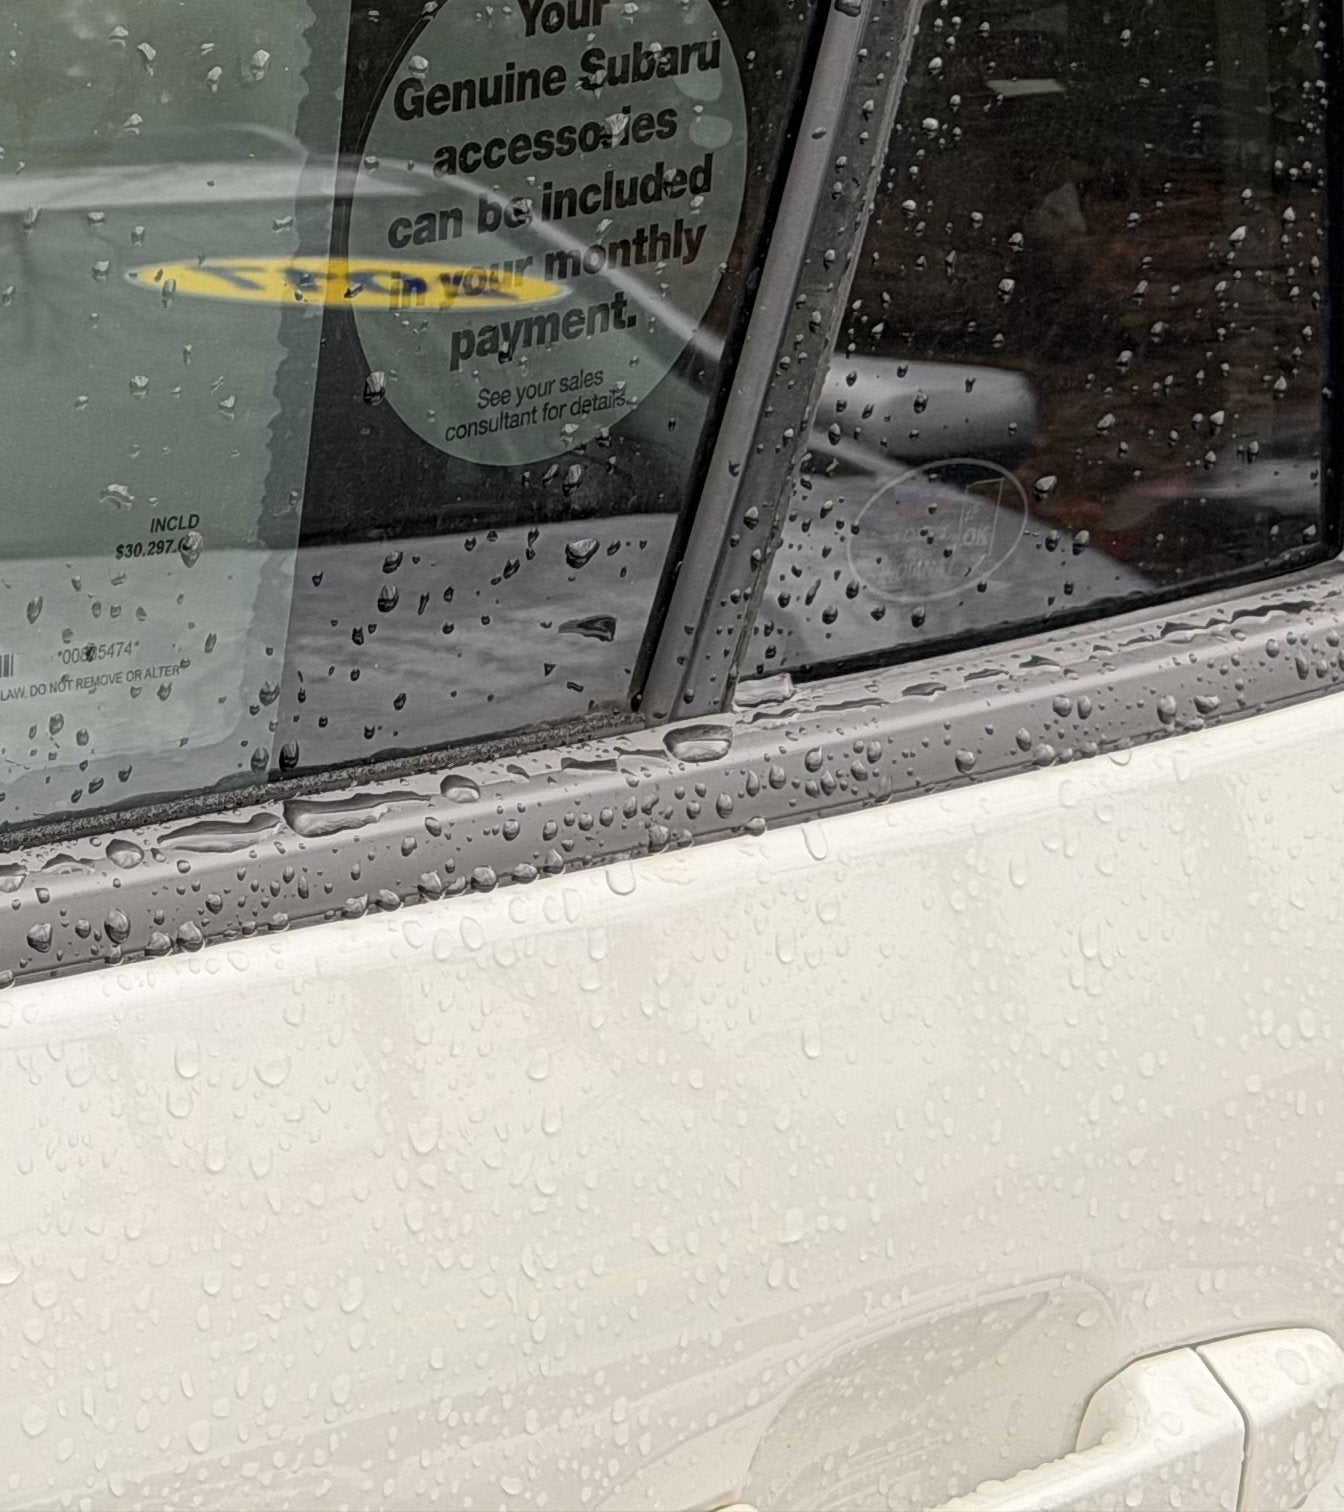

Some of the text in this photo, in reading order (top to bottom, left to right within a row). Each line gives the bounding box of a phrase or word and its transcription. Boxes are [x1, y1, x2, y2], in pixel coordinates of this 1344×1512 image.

[393, 38, 721, 122] Genuine Subaru
[387, 207, 464, 248] can
[540, 153, 715, 221] included
[438, 259, 535, 311] your
[545, 219, 708, 281] monthly
[449, 292, 637, 371] payment.
[445, 410, 539, 441] consultant
[542, 399, 567, 422] for
[478, 367, 604, 410] See your sales
[149, 513, 200, 534] INCLD
